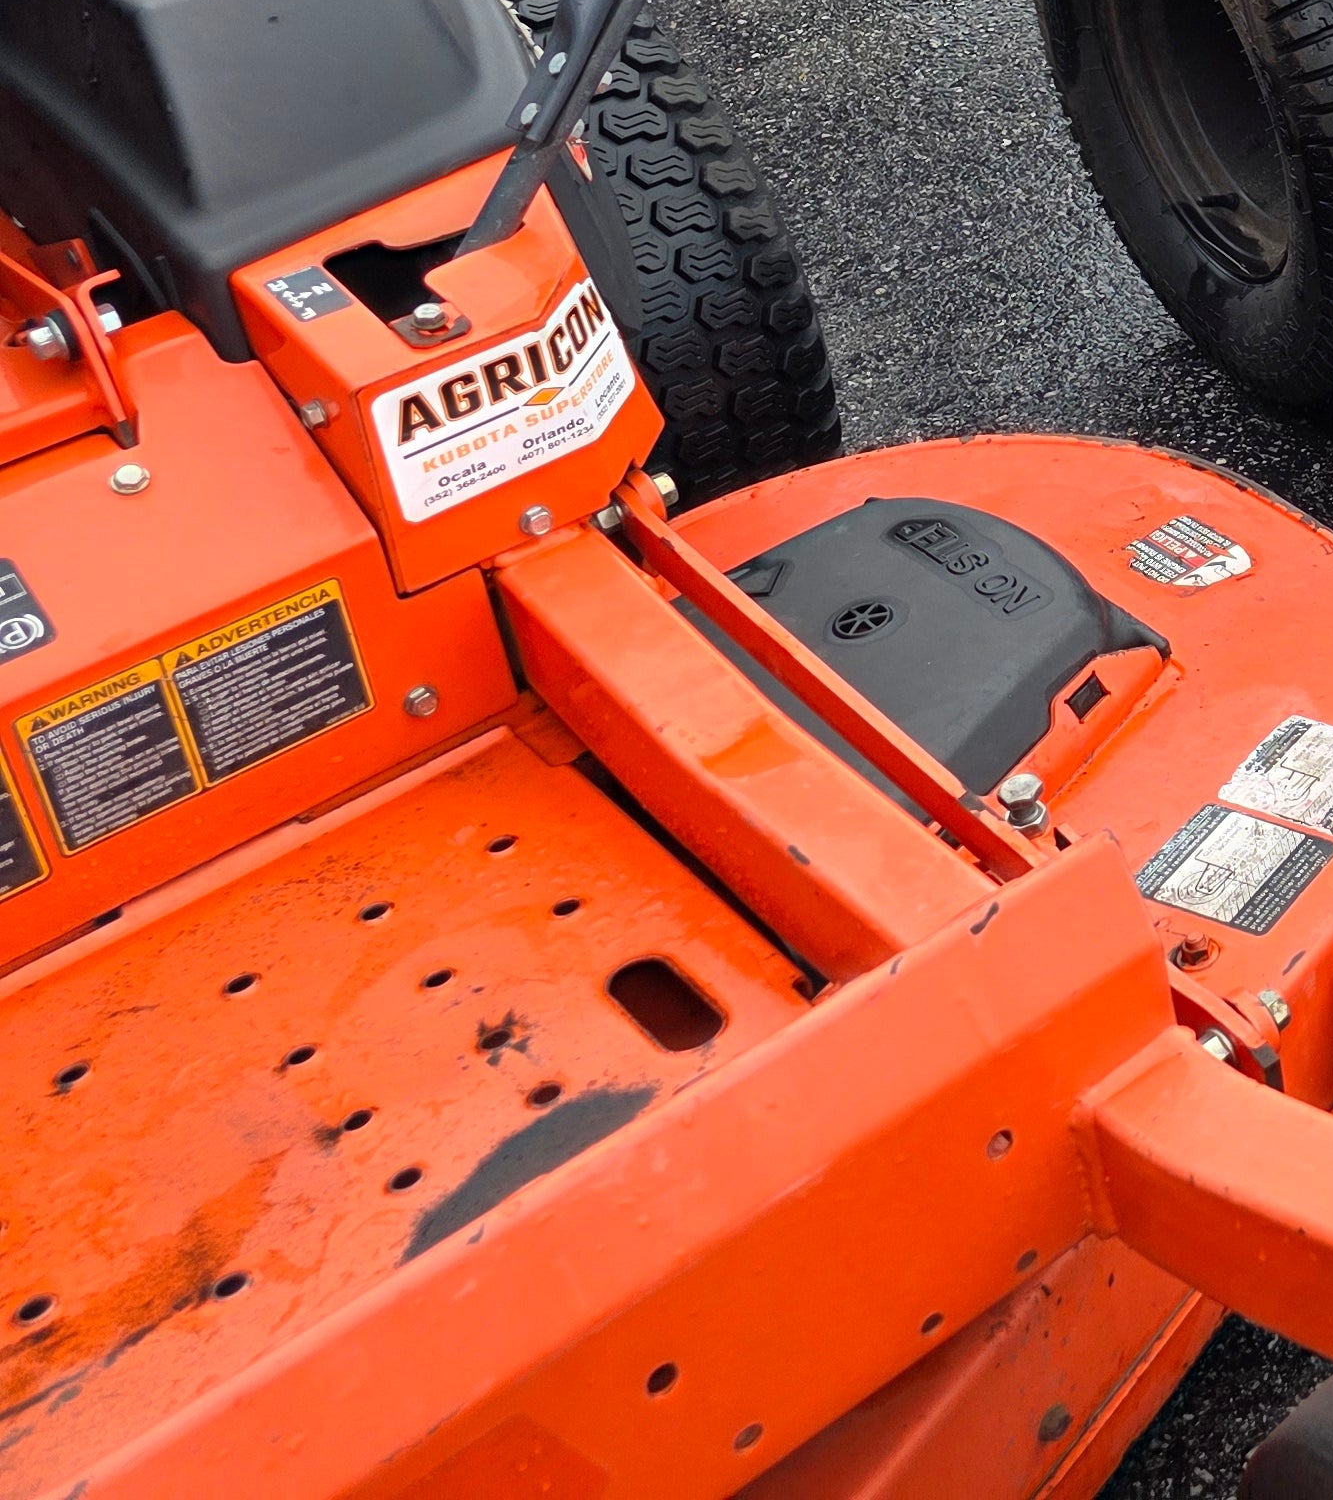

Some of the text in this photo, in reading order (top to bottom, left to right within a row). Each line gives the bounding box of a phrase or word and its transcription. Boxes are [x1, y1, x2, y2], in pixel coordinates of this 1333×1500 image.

[267, 280, 289, 291] R
[398, 285, 606, 446] AGRICON
[594, 371, 621, 409] Lecanto
[422, 349, 615, 474] KUBOTA SUPERSTORE
[517, 423, 595, 465] (407) 801-1234
[522, 416, 585, 450] Orlando
[424, 464, 506, 508] (352) 368-2400
[438, 460, 487, 488] Ocala
[1149, 527, 1187, 556] PELIG
[1144, 566, 1159, 579] NOT
[1157, 574, 1169, 585] DO
[1160, 565, 1177, 579] FEET
[974, 571, 1040, 614] NO
[196, 588, 331, 657] ADVERTENCIA
[175, 607, 325, 681] PARA EVITAR LESIONES PERSONALES
[177, 668, 213, 689] GRAVES
[221, 659, 234, 669] LA
[234, 642, 269, 664] MUERTE
[31, 683, 157, 746] TO AVOID SERIOUS INJURY
[48, 672, 141, 721] WARNING
[34, 726, 85, 754] OR DEATH
[1247, 897, 1281, 929] premature
[1294, 863, 1311, 877] wear
[1251, 892, 1276, 914] ground
[1254, 906, 1282, 931] develop
